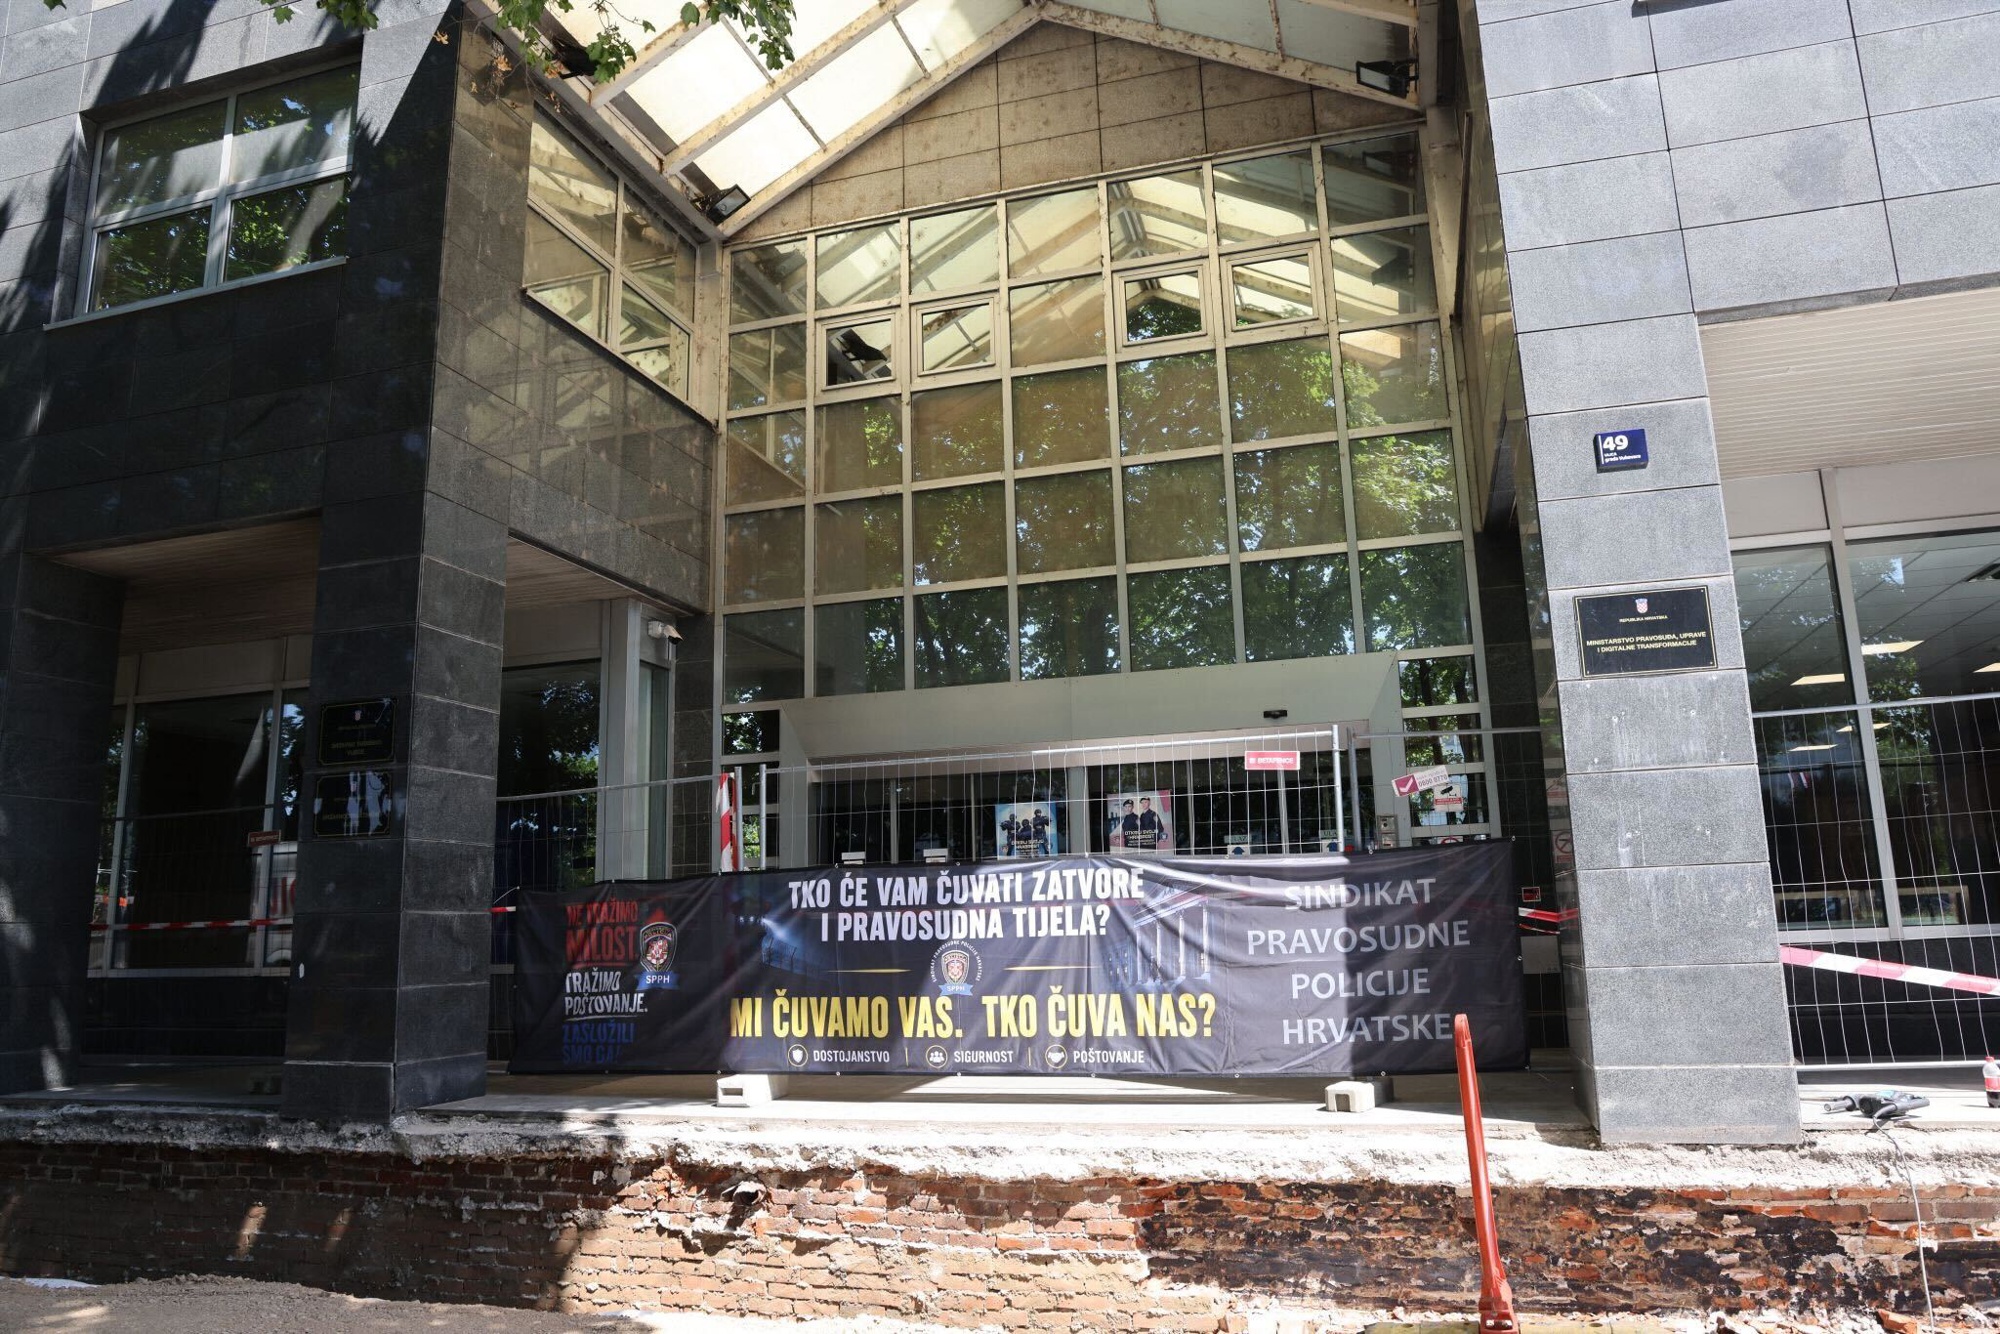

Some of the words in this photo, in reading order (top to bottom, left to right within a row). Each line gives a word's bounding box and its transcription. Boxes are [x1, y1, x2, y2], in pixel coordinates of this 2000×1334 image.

[1603, 434, 1629, 451] 49
[1586, 636, 1635, 647] MINISTARSTVO
[1679, 631, 1707, 640] UPRAVE
[1601, 644, 1636, 653] DIGITALNE
[1637, 639, 1698, 650] TRANSFORMACIJE
[788, 878, 831, 909] TKO
[839, 871, 868, 907] ĆE
[876, 876, 929, 907] VAM
[936, 869, 1023, 905] ČUVATI
[1032, 867, 1145, 901] ZATVORE
[1284, 878, 1437, 910] SINDIKAT
[821, 912, 829, 942] I
[837, 906, 1004, 942] PRAVOSUDNA
[1013, 904, 1111, 938] TIJELA?
[1247, 920, 1471, 955] PRAVOSUDNE
[565, 967, 622, 993] TRAŽIMO
[645, 974, 670, 984] SPPH
[1291, 968, 1431, 999] POLICIJE
[564, 991, 649, 1016] POŠTOVANJE.
[730, 997, 763, 1038] MI
[772, 988, 889, 1038] ČUVAMO
[897, 995, 963, 1039] VAS.
[981, 994, 1038, 1038] TKO
[1048, 985, 1128, 1038] ČUVA
[1136, 992, 1217, 1038] NAS?
[562, 1019, 636, 1044] ZASLUŽILI
[1283, 1013, 1453, 1045] HRVATSKE
[813, 1050, 890, 1064] DOSTOJANSTVO
[953, 1050, 1014, 1064] SIGURNOST
[1073, 1047, 1145, 1064] POŠTOVANJE
